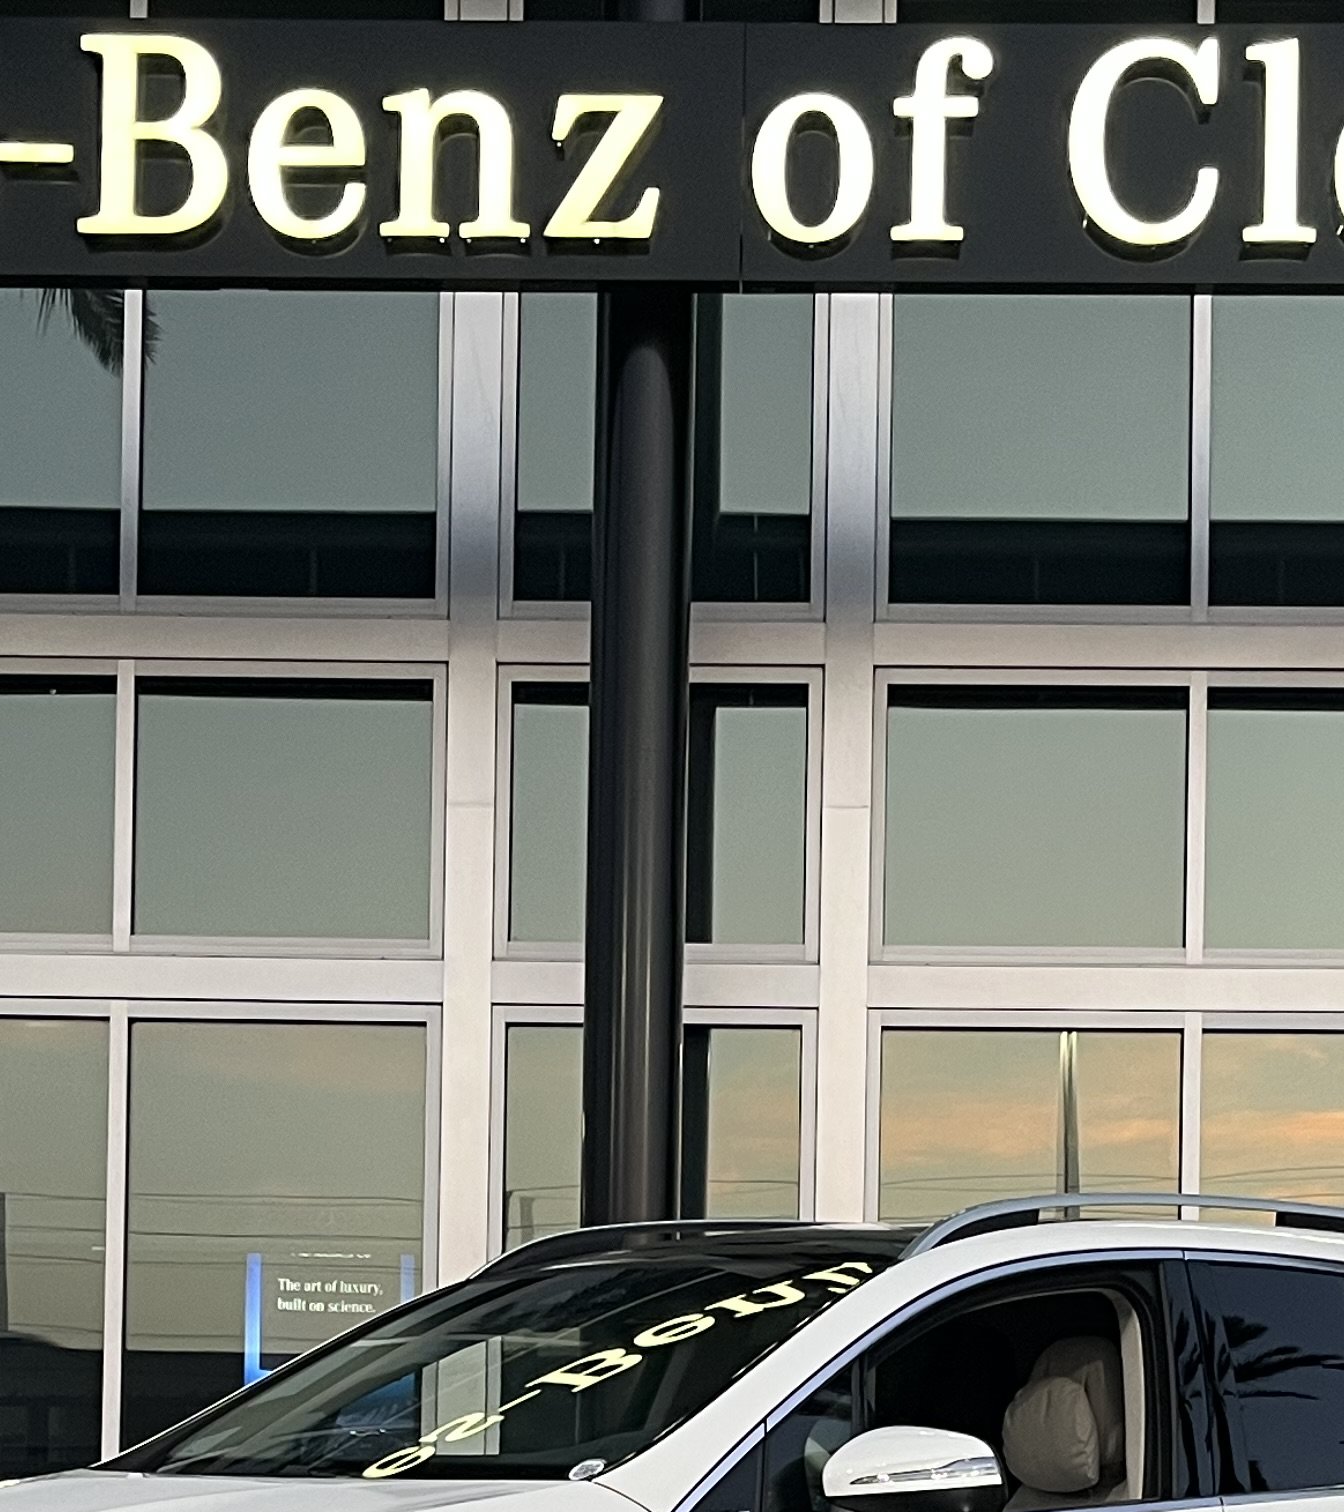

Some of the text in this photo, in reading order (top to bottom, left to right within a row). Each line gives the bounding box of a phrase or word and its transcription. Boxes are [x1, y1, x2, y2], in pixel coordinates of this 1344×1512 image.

[750, 36, 994, 244] of
[277, 1277, 384, 1297] The art of luxury,
[277, 1297, 377, 1313] built on science.
